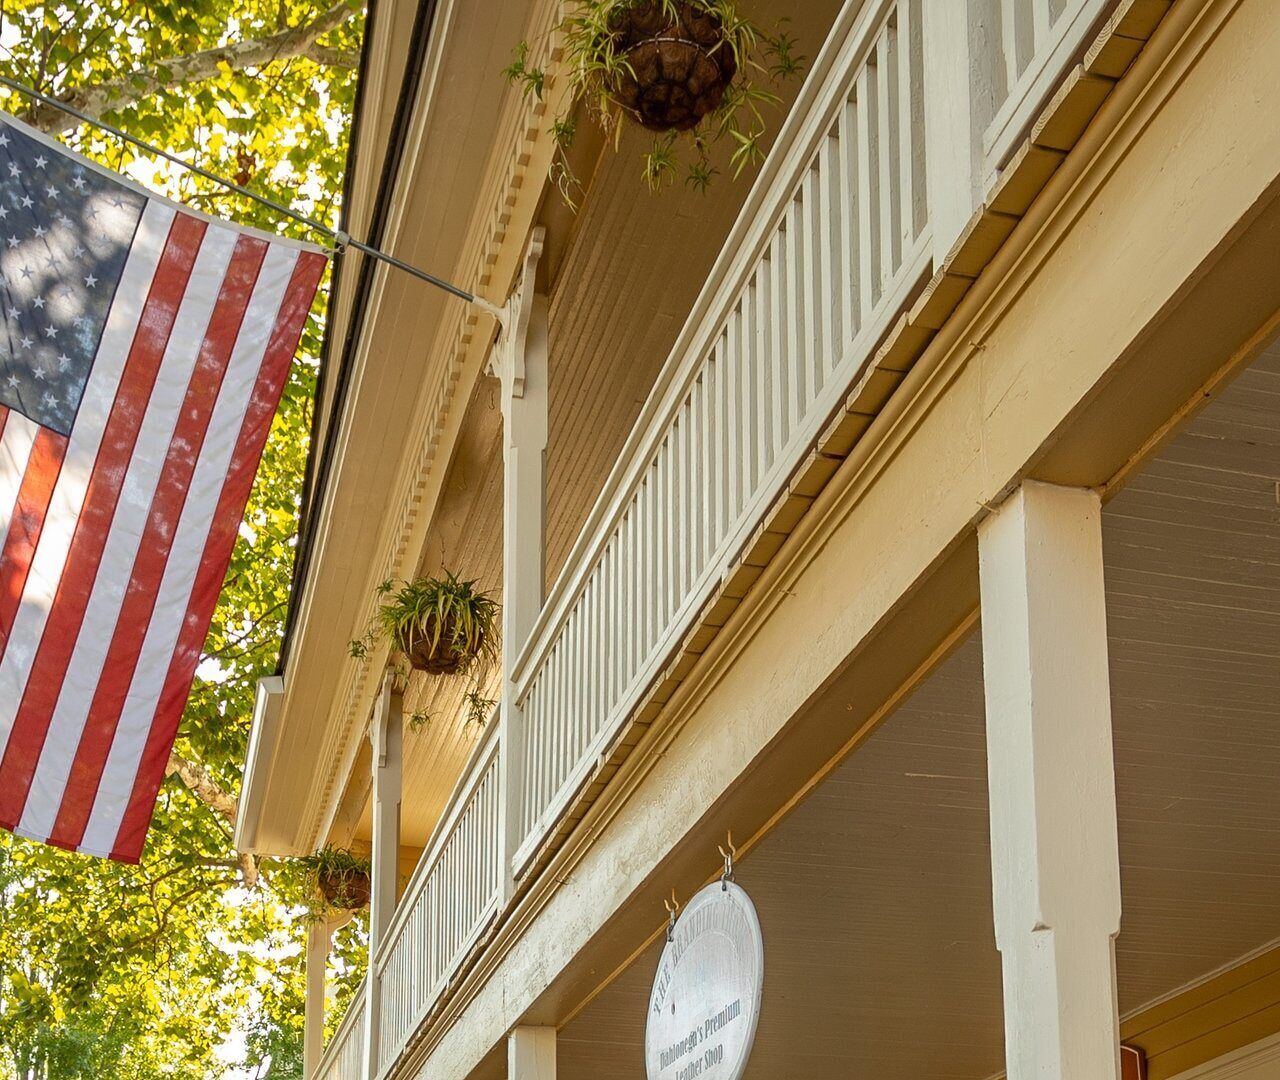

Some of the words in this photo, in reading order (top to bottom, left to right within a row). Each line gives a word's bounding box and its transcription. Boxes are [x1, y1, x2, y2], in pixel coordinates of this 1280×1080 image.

[651, 964, 671, 1017] THE
[659, 1025, 703, 1071] Dahlonega's
[704, 998, 741, 1038] Premium
[704, 1043, 723, 1070] Shop
